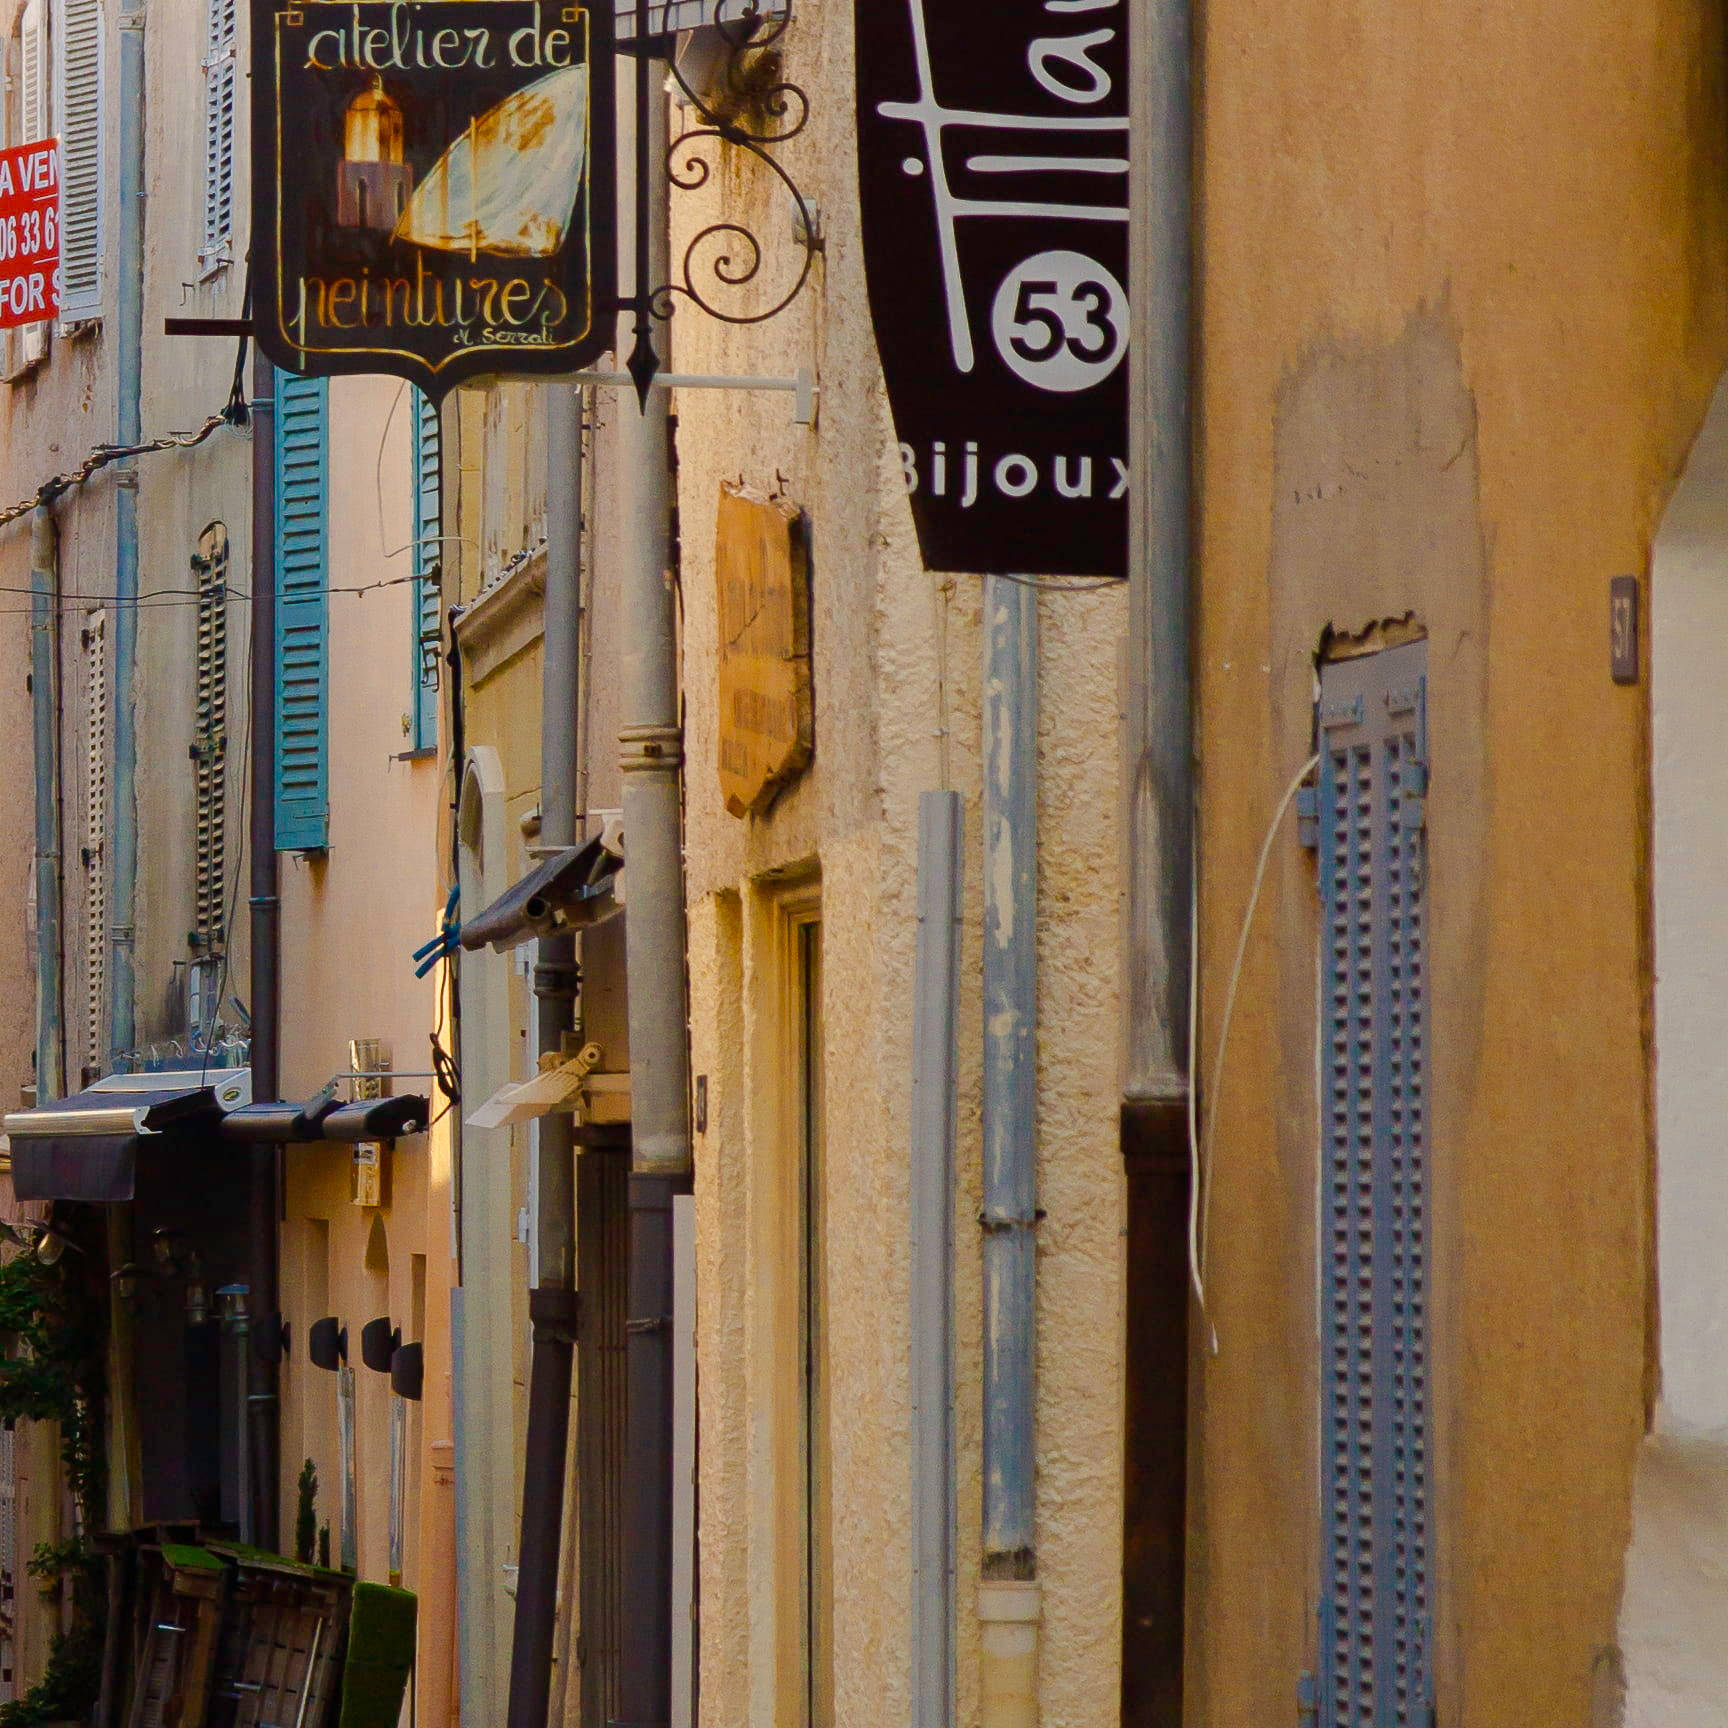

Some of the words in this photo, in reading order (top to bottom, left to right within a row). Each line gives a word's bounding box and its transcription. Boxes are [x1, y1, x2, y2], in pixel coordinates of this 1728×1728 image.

[304, 2, 494, 70] atelier
[21, 210, 40, 256] 33
[45, 206, 59, 250] 6
[289, 248, 568, 370] peintures
[1010, 280, 1117, 364] 53
